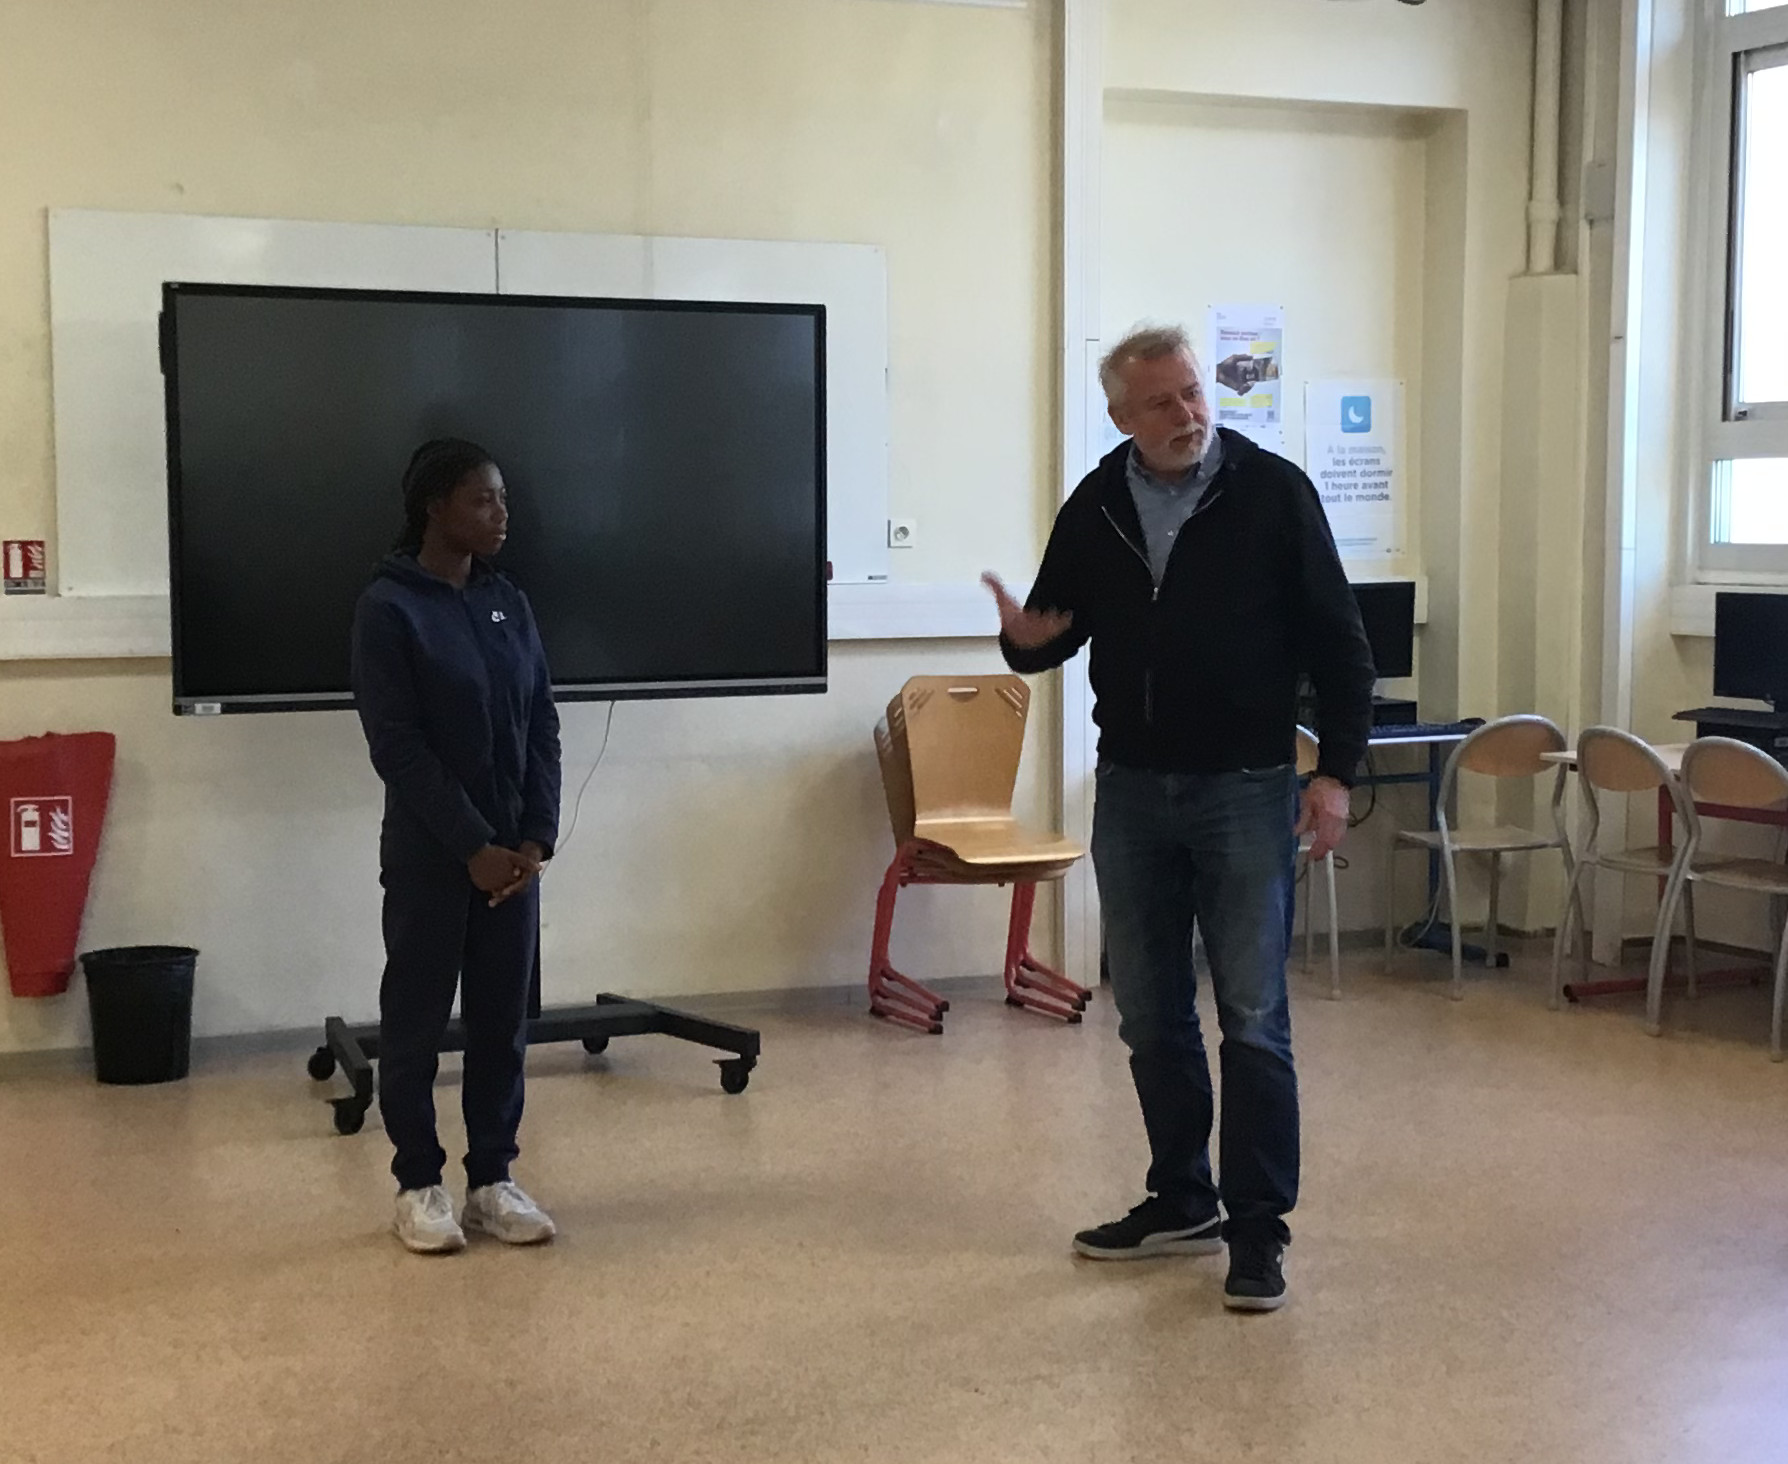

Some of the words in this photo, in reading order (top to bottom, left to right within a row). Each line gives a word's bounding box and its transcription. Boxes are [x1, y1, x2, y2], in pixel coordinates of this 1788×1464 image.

[1332, 457, 1346, 466] les
[1349, 457, 1381, 466] écrans
[1320, 470, 1357, 479] doivent
[1360, 469, 1393, 478] dormir
[1324, 481, 1329, 490] 1
[1331, 481, 1359, 490] heure
[1361, 481, 1389, 490] avant
[1321, 493, 1342, 503] tout
[1344, 493, 1353, 502] le
